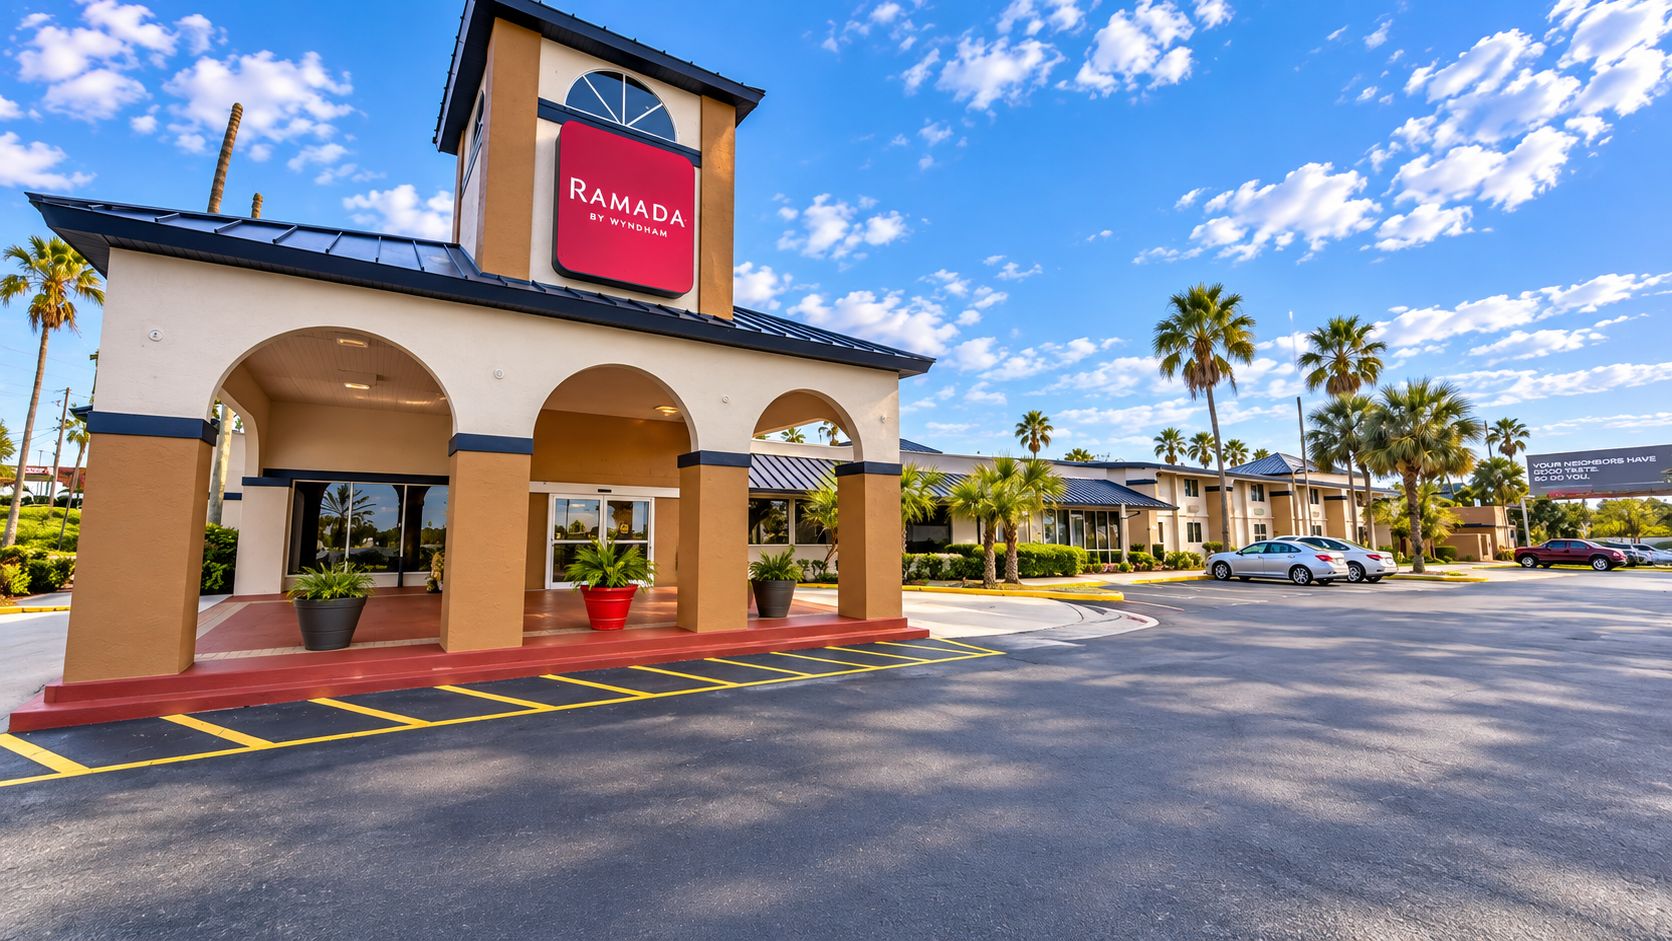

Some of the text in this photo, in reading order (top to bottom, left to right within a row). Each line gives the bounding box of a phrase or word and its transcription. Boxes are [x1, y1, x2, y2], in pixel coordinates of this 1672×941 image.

[570, 176, 685, 227] RAMADA
[590, 212, 667, 237] BY WYNDHAM
[1564, 457, 1624, 467] NEIGHBORS
[1627, 455, 1656, 463] HAVE
